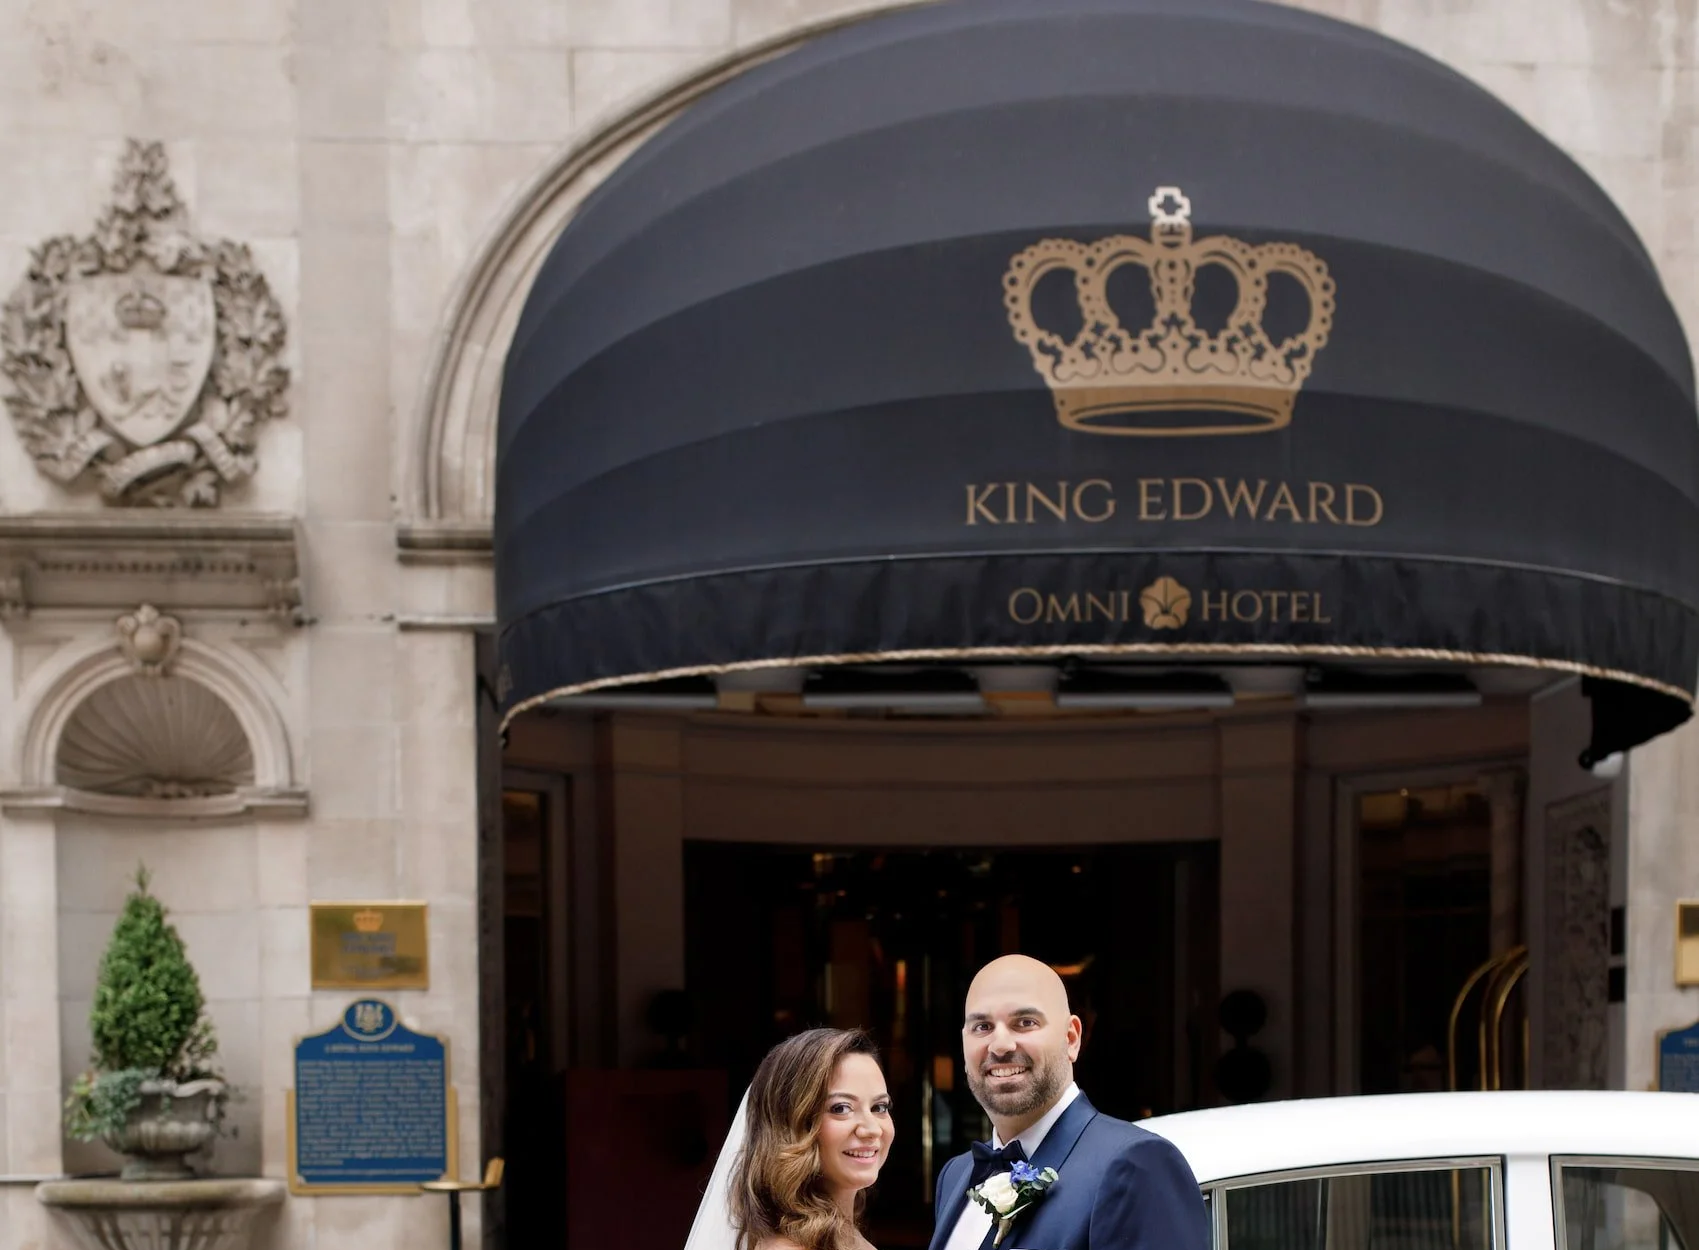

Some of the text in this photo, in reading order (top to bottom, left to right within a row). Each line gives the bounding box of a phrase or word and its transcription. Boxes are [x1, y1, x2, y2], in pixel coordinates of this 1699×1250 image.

[965, 478, 1384, 526] KING EDWARD
[1201, 591, 1331, 624] HOTEL
